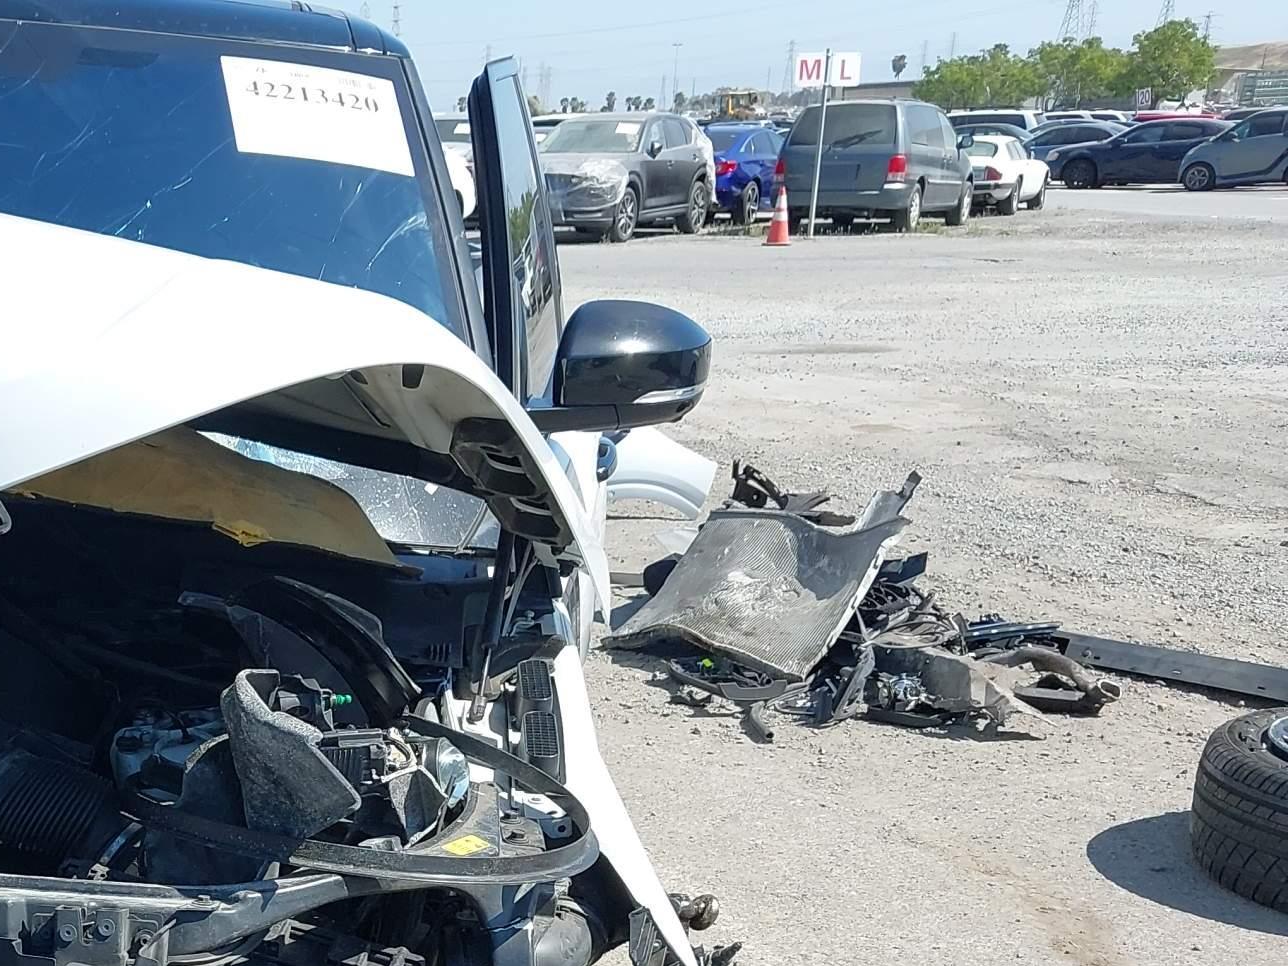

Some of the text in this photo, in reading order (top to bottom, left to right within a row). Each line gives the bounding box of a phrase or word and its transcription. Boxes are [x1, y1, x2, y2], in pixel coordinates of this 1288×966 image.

[799, 59, 821, 80] M
[840, 59, 852, 80] L
[245, 80, 379, 113] 42213420
[1139, 90, 1150, 104] 20
